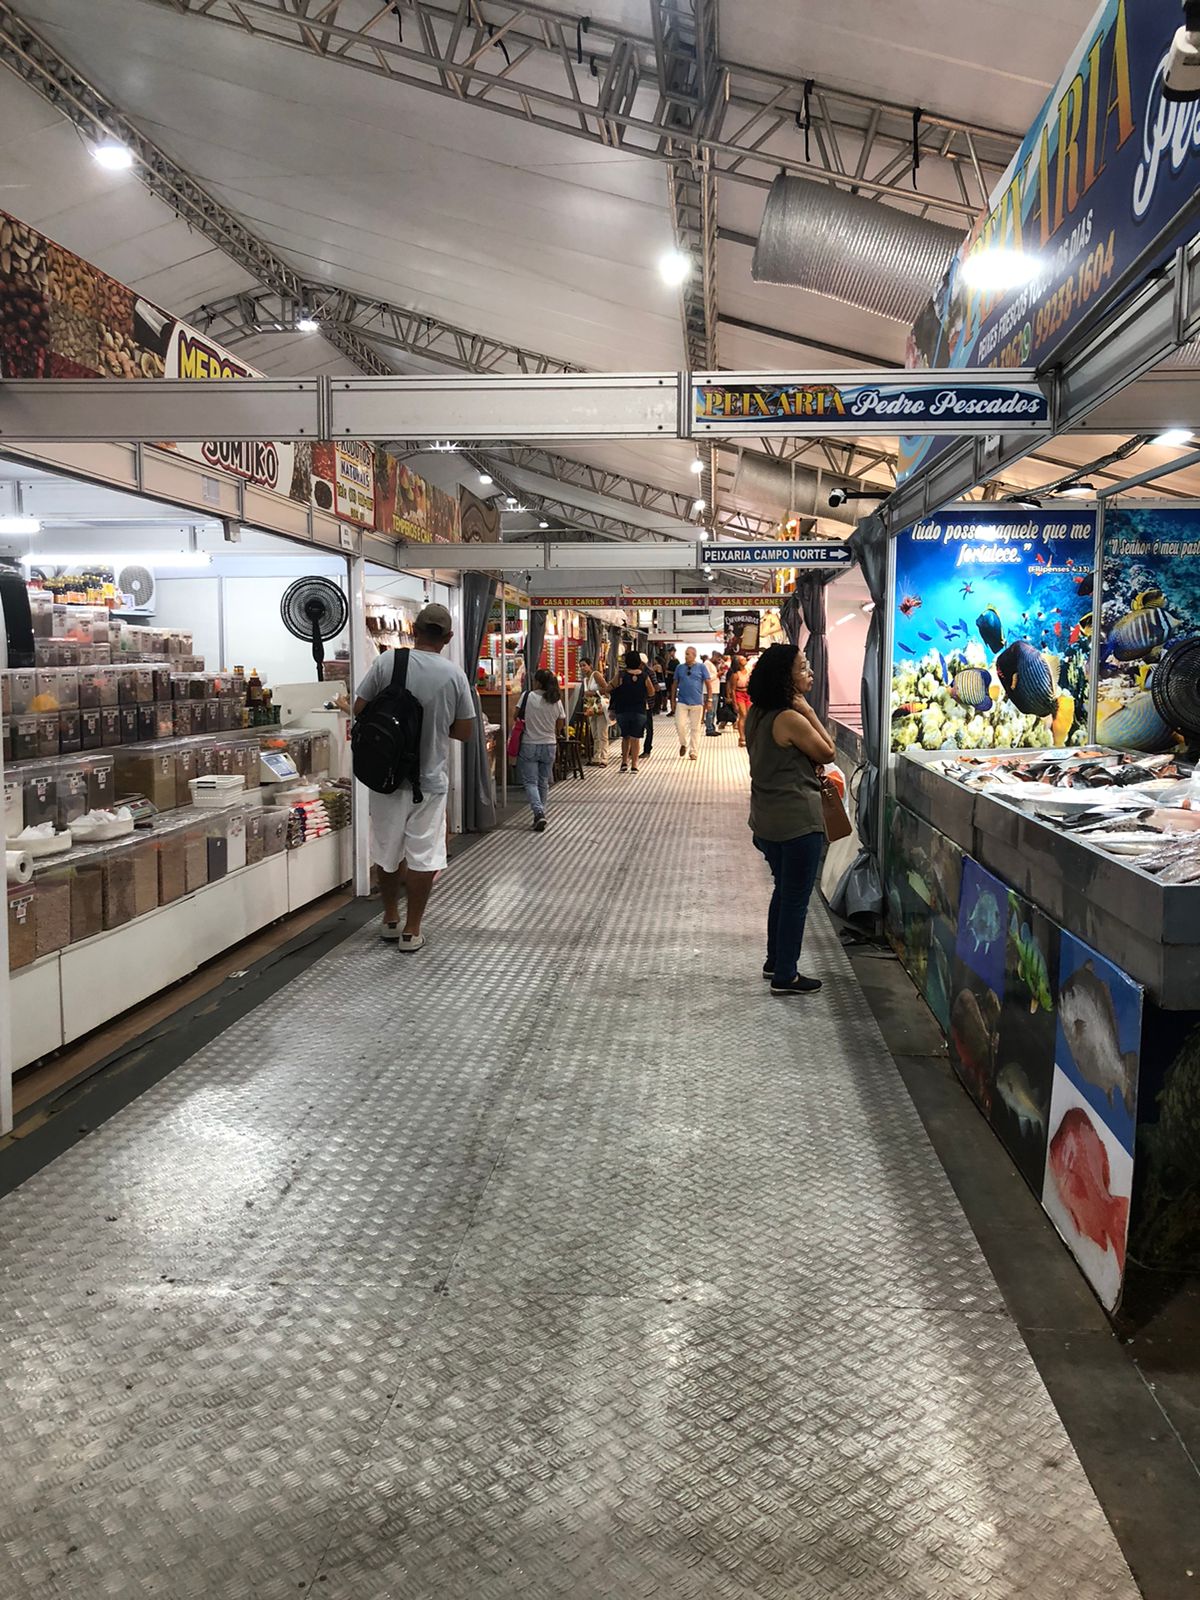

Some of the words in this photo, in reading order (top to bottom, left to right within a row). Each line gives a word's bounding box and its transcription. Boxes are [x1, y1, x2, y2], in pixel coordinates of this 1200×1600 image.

[977, 322, 999, 365] PEIXES
[999, 286, 1029, 340] FRESCOS
[1068, 208, 1093, 264] DIAS
[702, 390, 846, 417] PEIXARIA
[851, 390, 926, 417] Pedro
[929, 390, 1040, 416] Pescados
[1042, 523, 1067, 544] que
[1070, 524, 1092, 540] me
[1120, 538, 1151, 555] Senhor
[1153, 538, 1160, 555] é
[1160, 542, 1180, 555] meu
[704, 549, 751, 562] PEIXARIA
[753, 549, 790, 561] CAMPO
[792, 548, 827, 560] NORTE
[542, 598, 563, 607] CASA
[564, 598, 574, 607] DE
[575, 598, 605, 607] CARNES
[631, 598, 651, 607] CASA
[652, 598, 662, 607] DE
[663, 598, 694, 607] CARNES
[721, 598, 740, 607] CASA
[741, 598, 751, 607] DE
